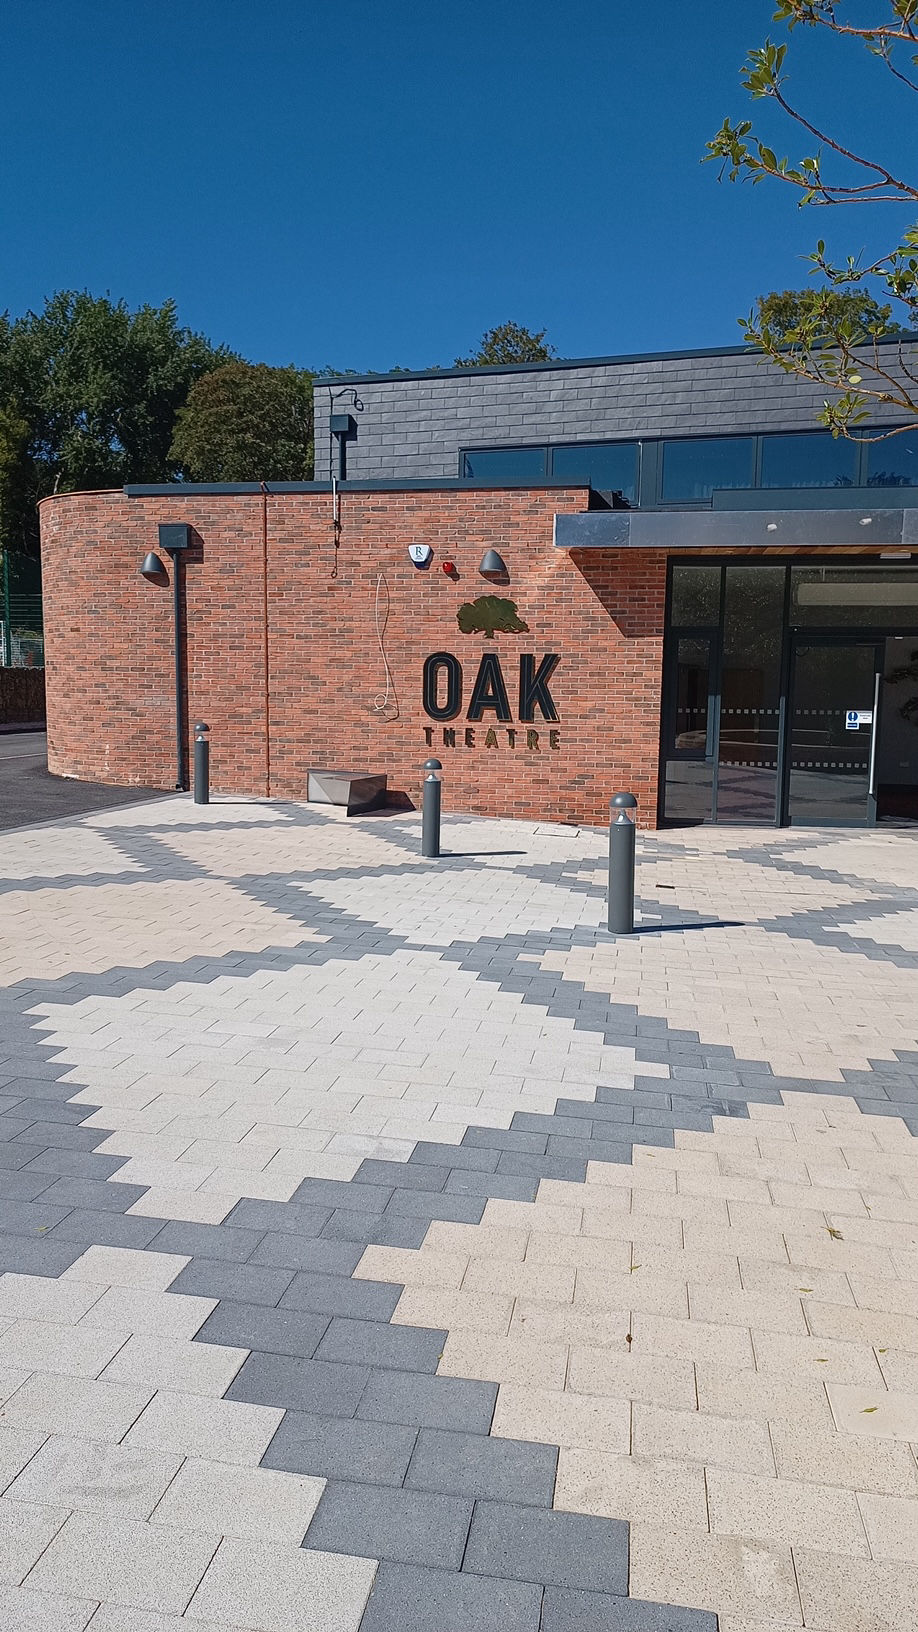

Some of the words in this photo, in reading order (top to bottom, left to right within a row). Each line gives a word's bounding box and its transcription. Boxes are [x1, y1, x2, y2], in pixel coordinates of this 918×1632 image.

[415, 546, 423, 556] R
[422, 651, 560, 723] OAK
[423, 727, 561, 750] THEATRE
